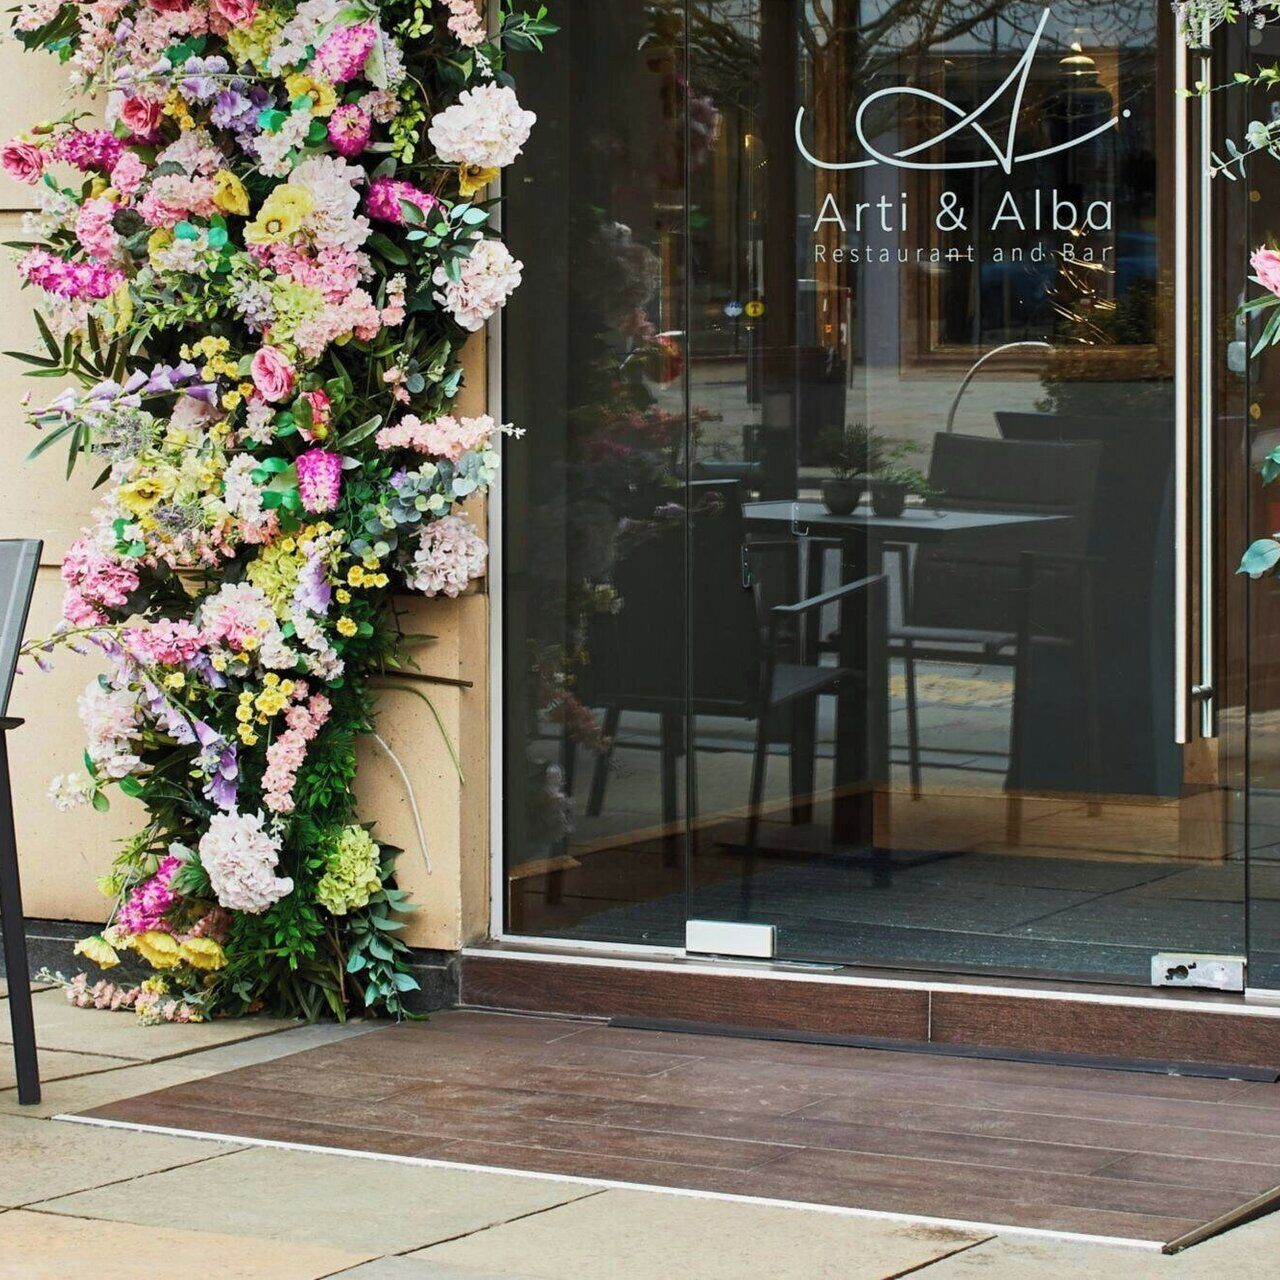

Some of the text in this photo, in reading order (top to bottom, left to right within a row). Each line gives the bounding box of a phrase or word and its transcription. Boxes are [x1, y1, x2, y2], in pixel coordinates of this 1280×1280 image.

[813, 188, 1112, 232] Arti & Alba
[814, 241, 1114, 263] Restaurant and Bar
